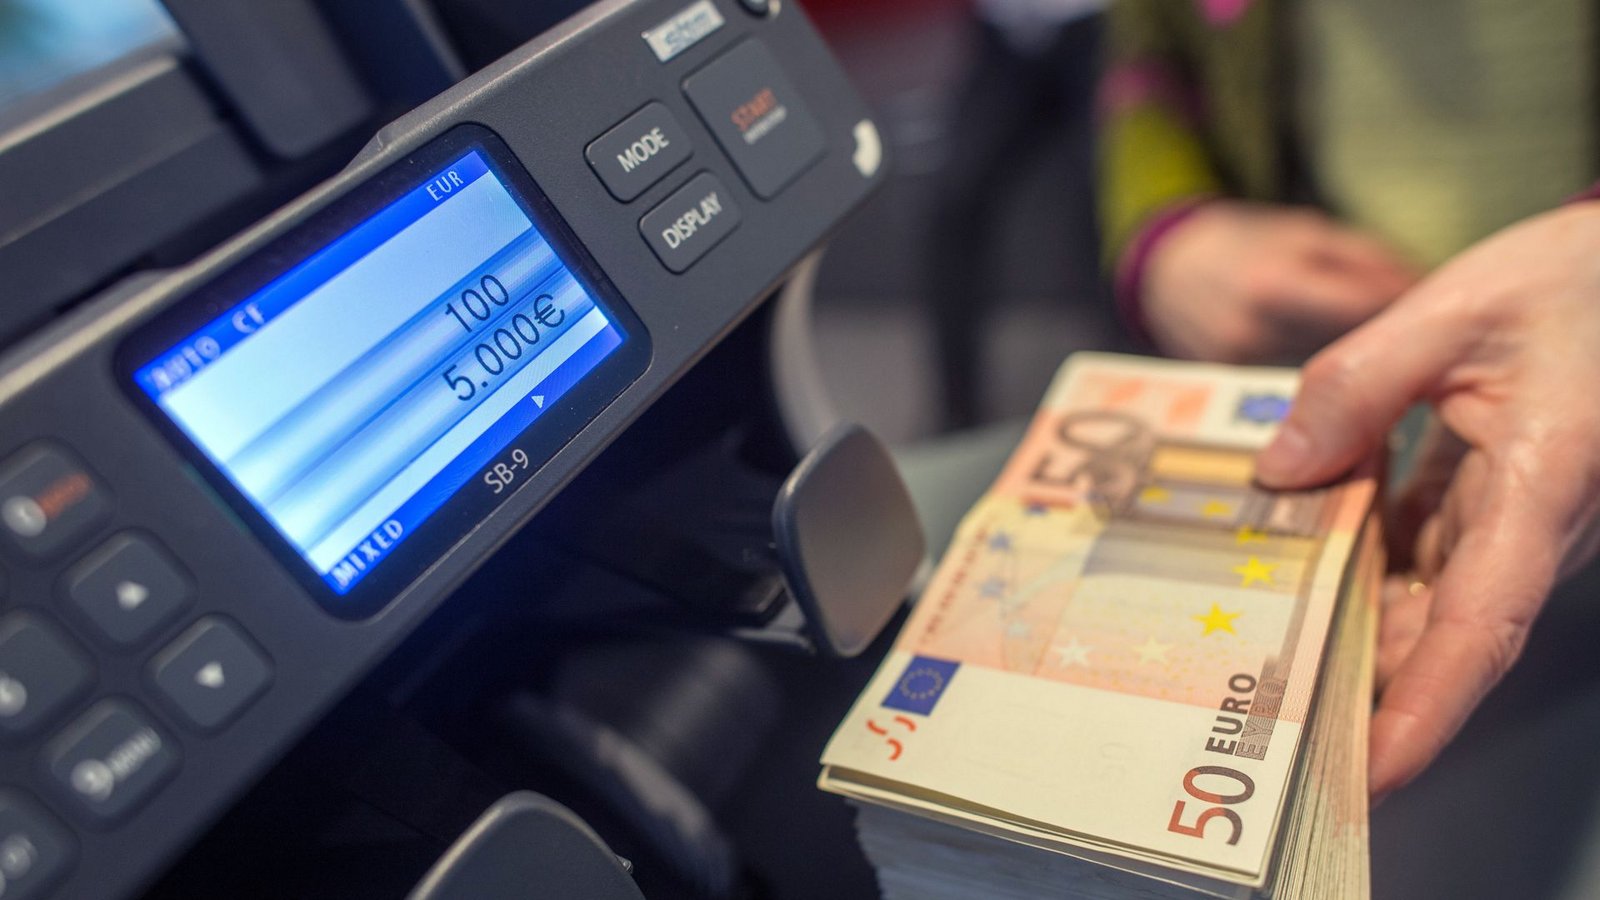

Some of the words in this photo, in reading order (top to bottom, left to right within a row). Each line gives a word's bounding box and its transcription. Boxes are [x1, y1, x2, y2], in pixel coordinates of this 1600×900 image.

[617, 126, 670, 172] MODE
[426, 169, 465, 202] EUR
[661, 191, 723, 249] DISPLAY
[444, 274, 509, 333] 100
[441, 293, 566, 402] 5.000€
[483, 448, 530, 494] SB-9
[331, 518, 405, 590] MIXED
[1204, 673, 1257, 755] EURO
[1167, 765, 1256, 846] 50
